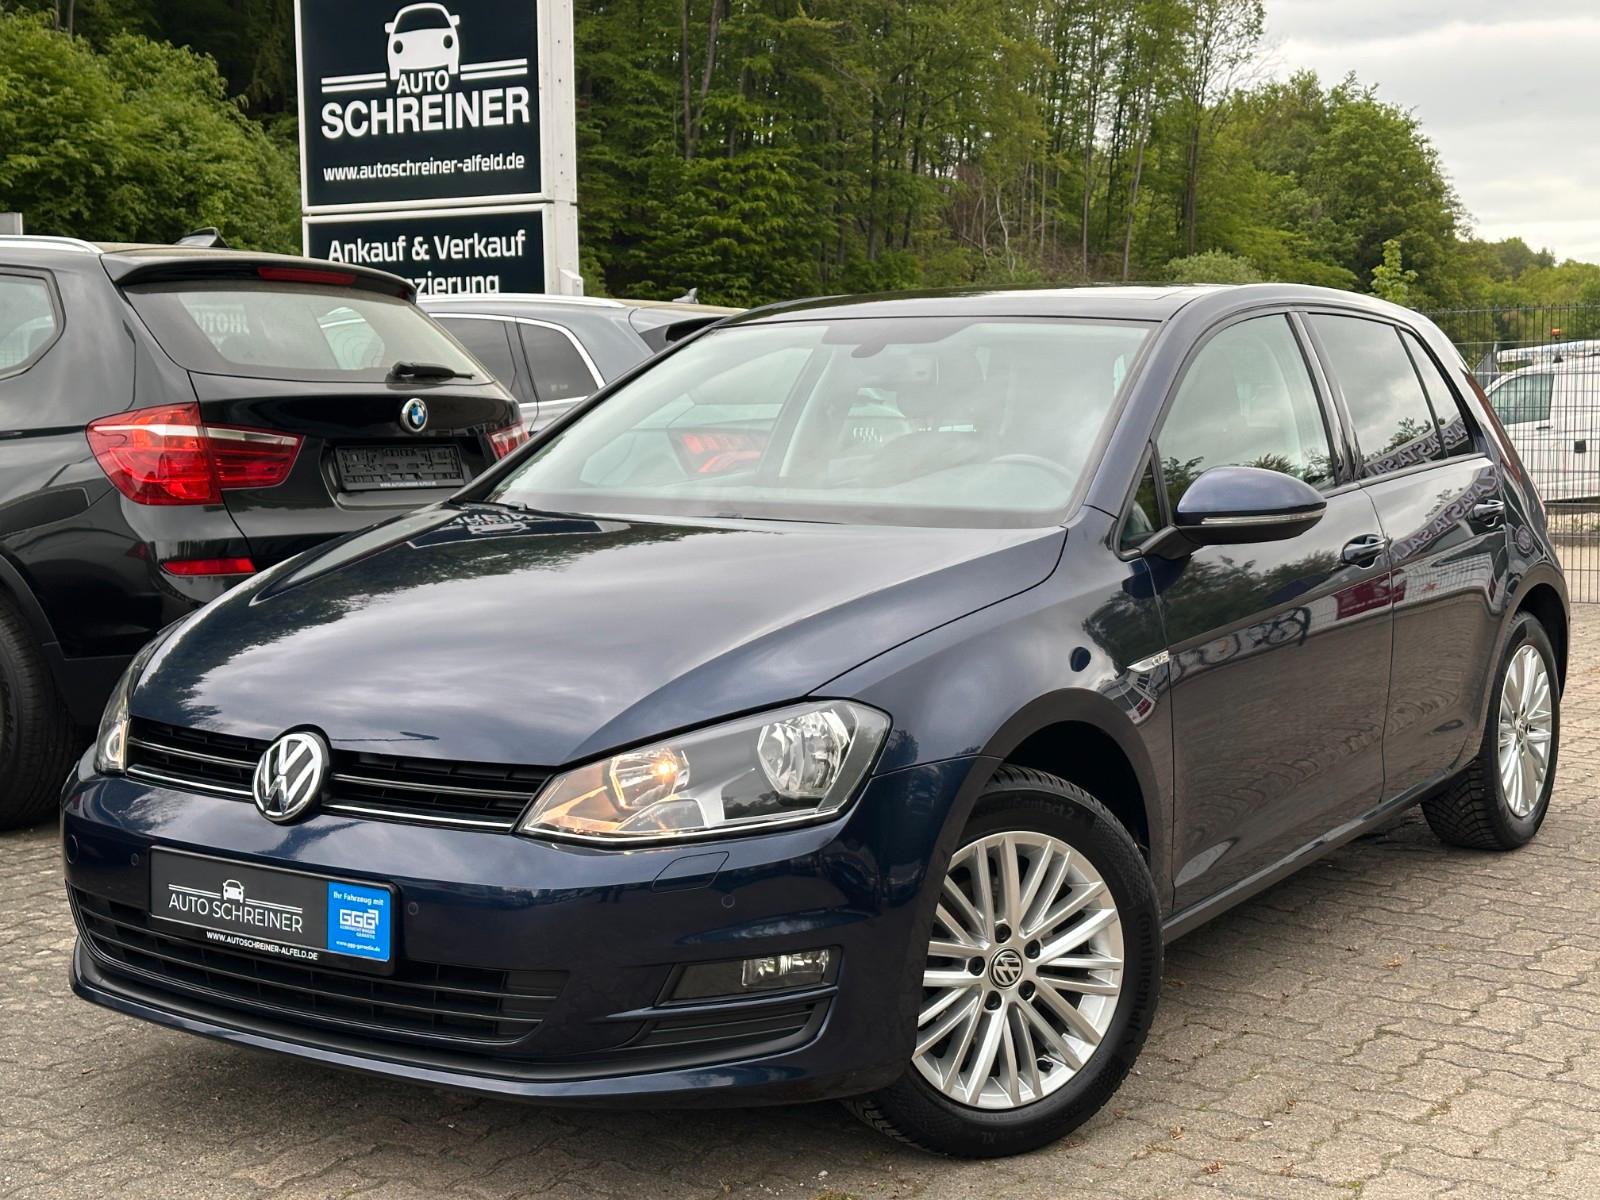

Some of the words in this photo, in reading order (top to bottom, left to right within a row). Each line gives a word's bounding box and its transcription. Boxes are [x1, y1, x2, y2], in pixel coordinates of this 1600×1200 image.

[397, 69, 449, 95] AUTO
[321, 86, 530, 139] SCHREINER
[323, 152, 525, 182] www.autoschreiner-alfeld.de
[327, 235, 406, 264] Ankauf
[411, 236, 430, 261] &
[433, 229, 526, 260] Verkauf
[406, 271, 499, 295] zierung
[168, 893, 209, 915] AUTO
[213, 901, 303, 933] SCHREINER
[333, 891, 342, 900] Ihr
[343, 892, 373, 906] Fahrzeug
[373, 898, 384, 906] mit
[340, 908, 377, 930] GGG
[206, 930, 318, 961] WWW.AUTOSCHREINER-ALFELD.DE
